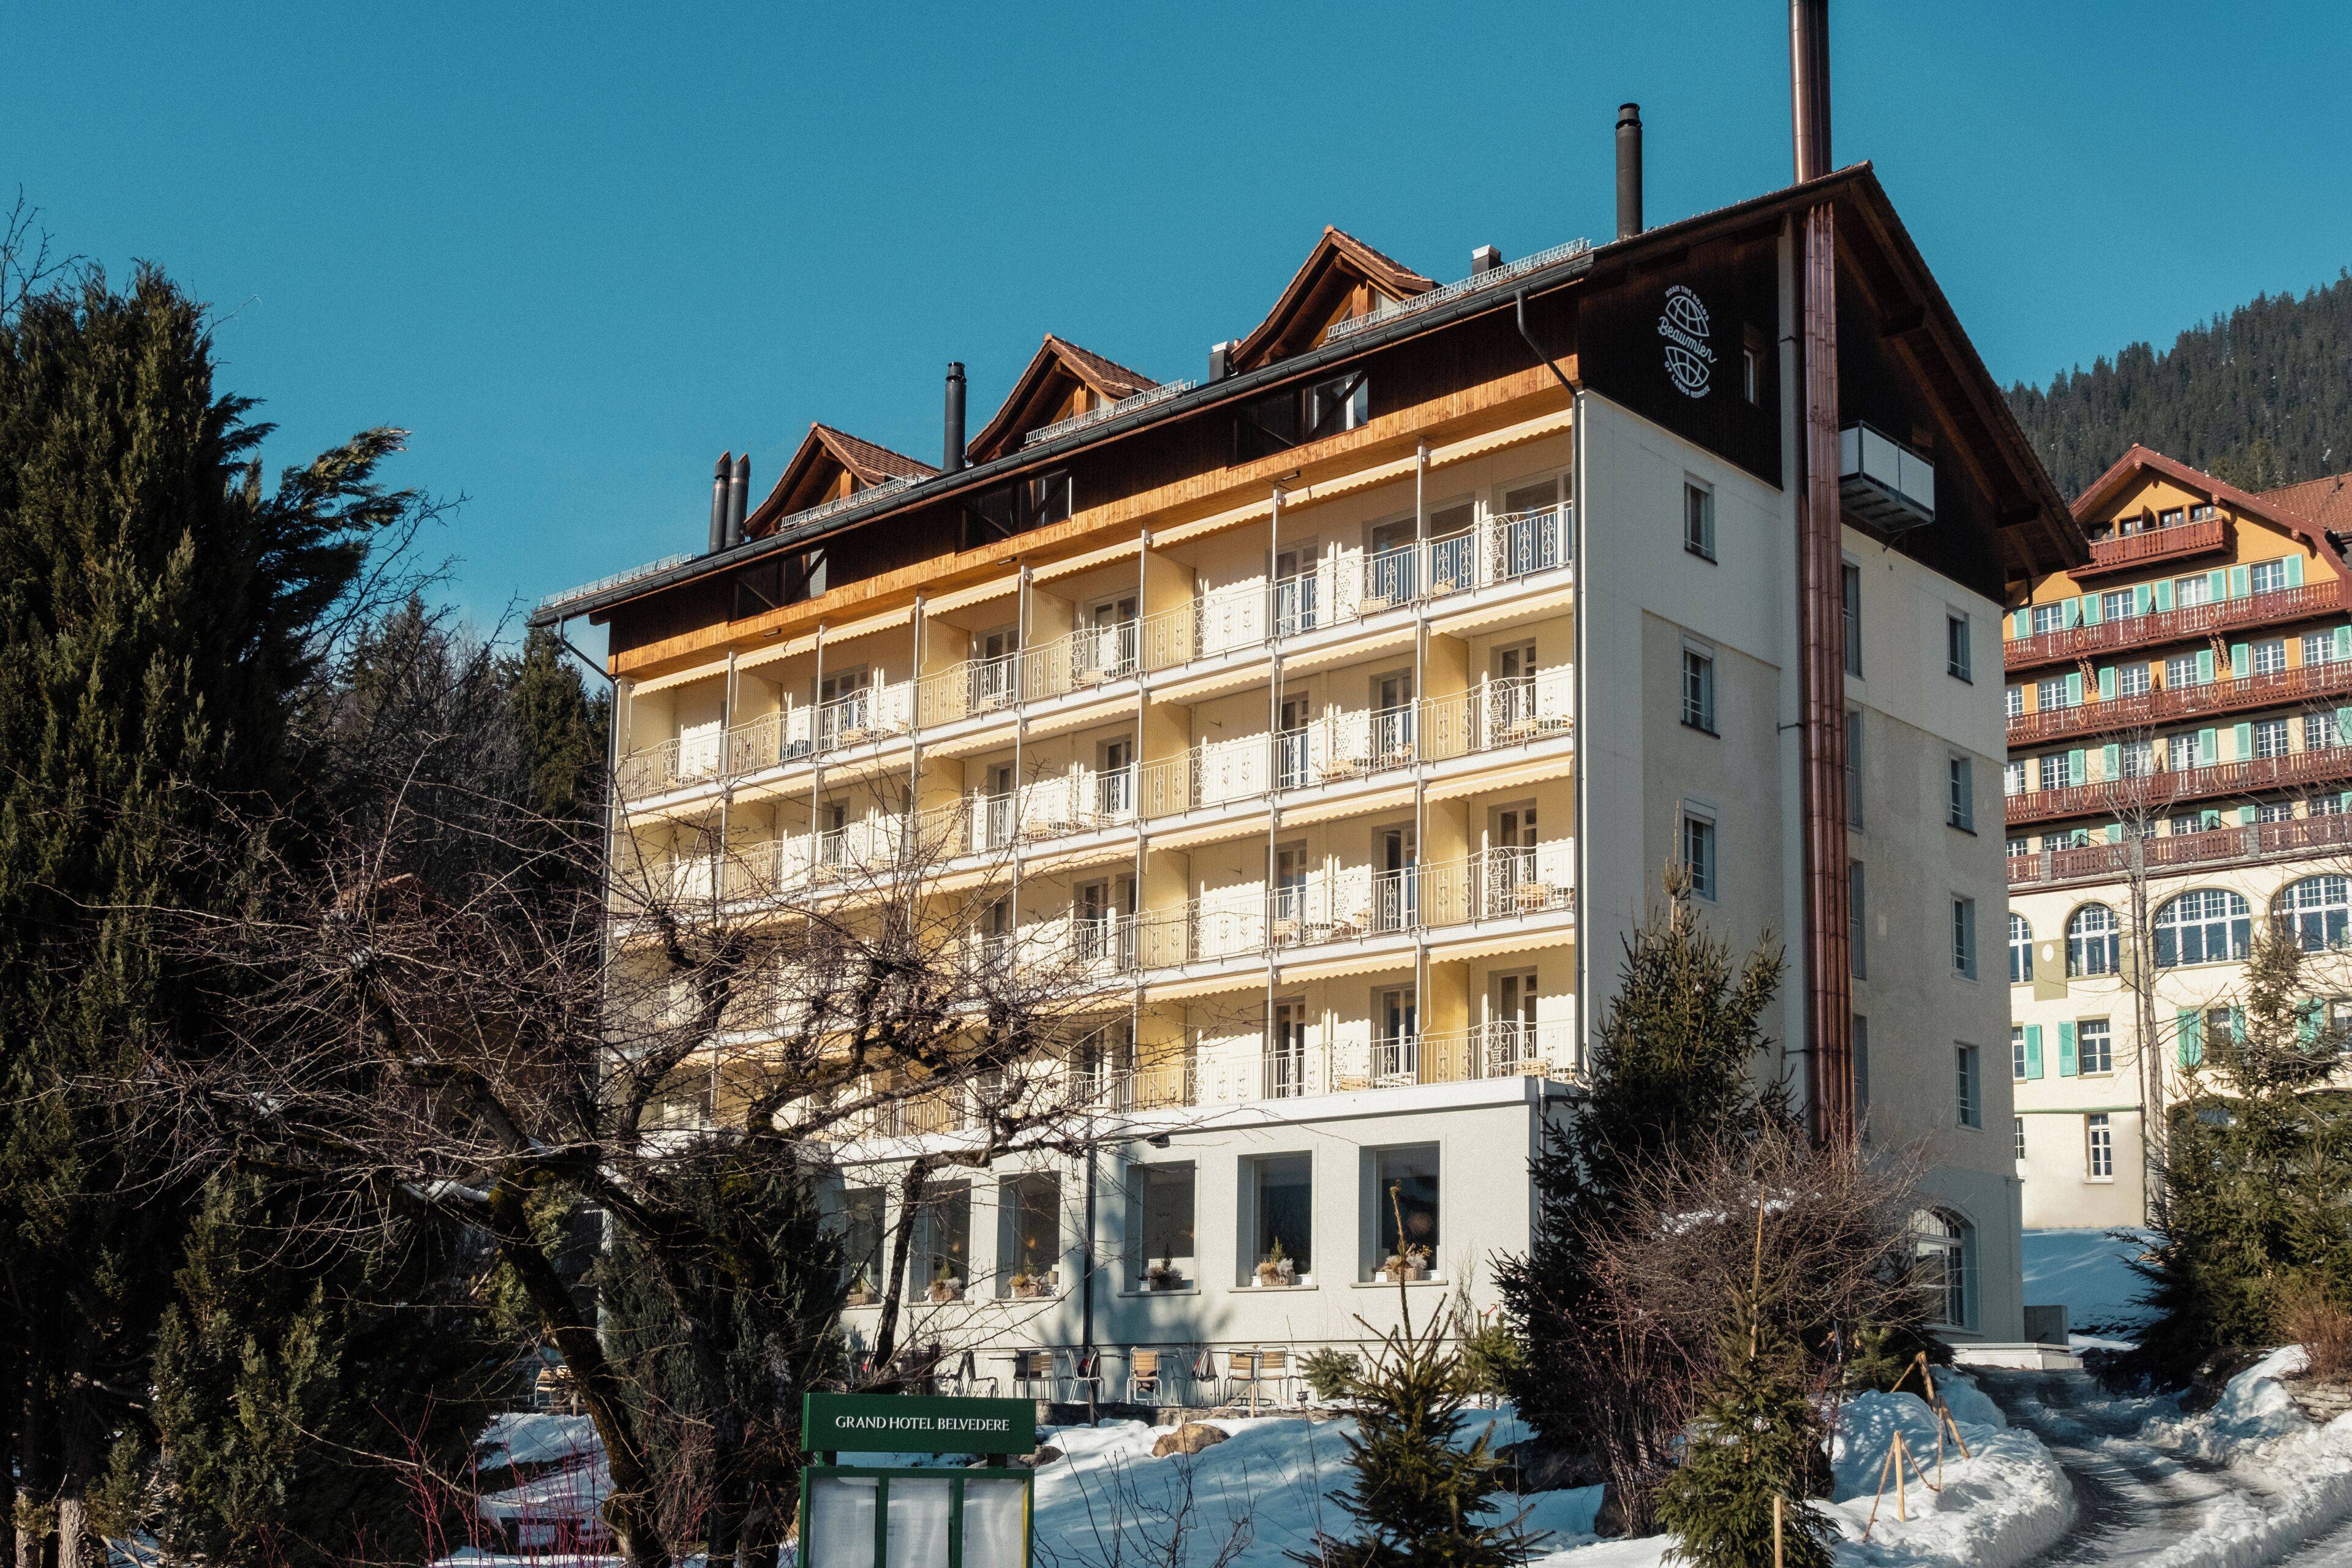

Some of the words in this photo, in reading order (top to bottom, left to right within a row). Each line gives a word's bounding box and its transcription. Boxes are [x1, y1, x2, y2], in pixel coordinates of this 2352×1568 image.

[1665, 285, 1680, 298] ROAM
[1680, 285, 1692, 296] THE
[1692, 294, 1709, 321] ROADS
[1657, 316, 1718, 363] Beaumier
[1664, 361, 1672, 372] OF
[1671, 374, 1689, 395] LANDS
[1690, 385, 1710, 398] REMOTE
[835, 1416, 886, 1429] GRAND
[889, 1417, 935, 1430] HOTEL
[938, 1418, 1010, 1431] BELVEDERE
